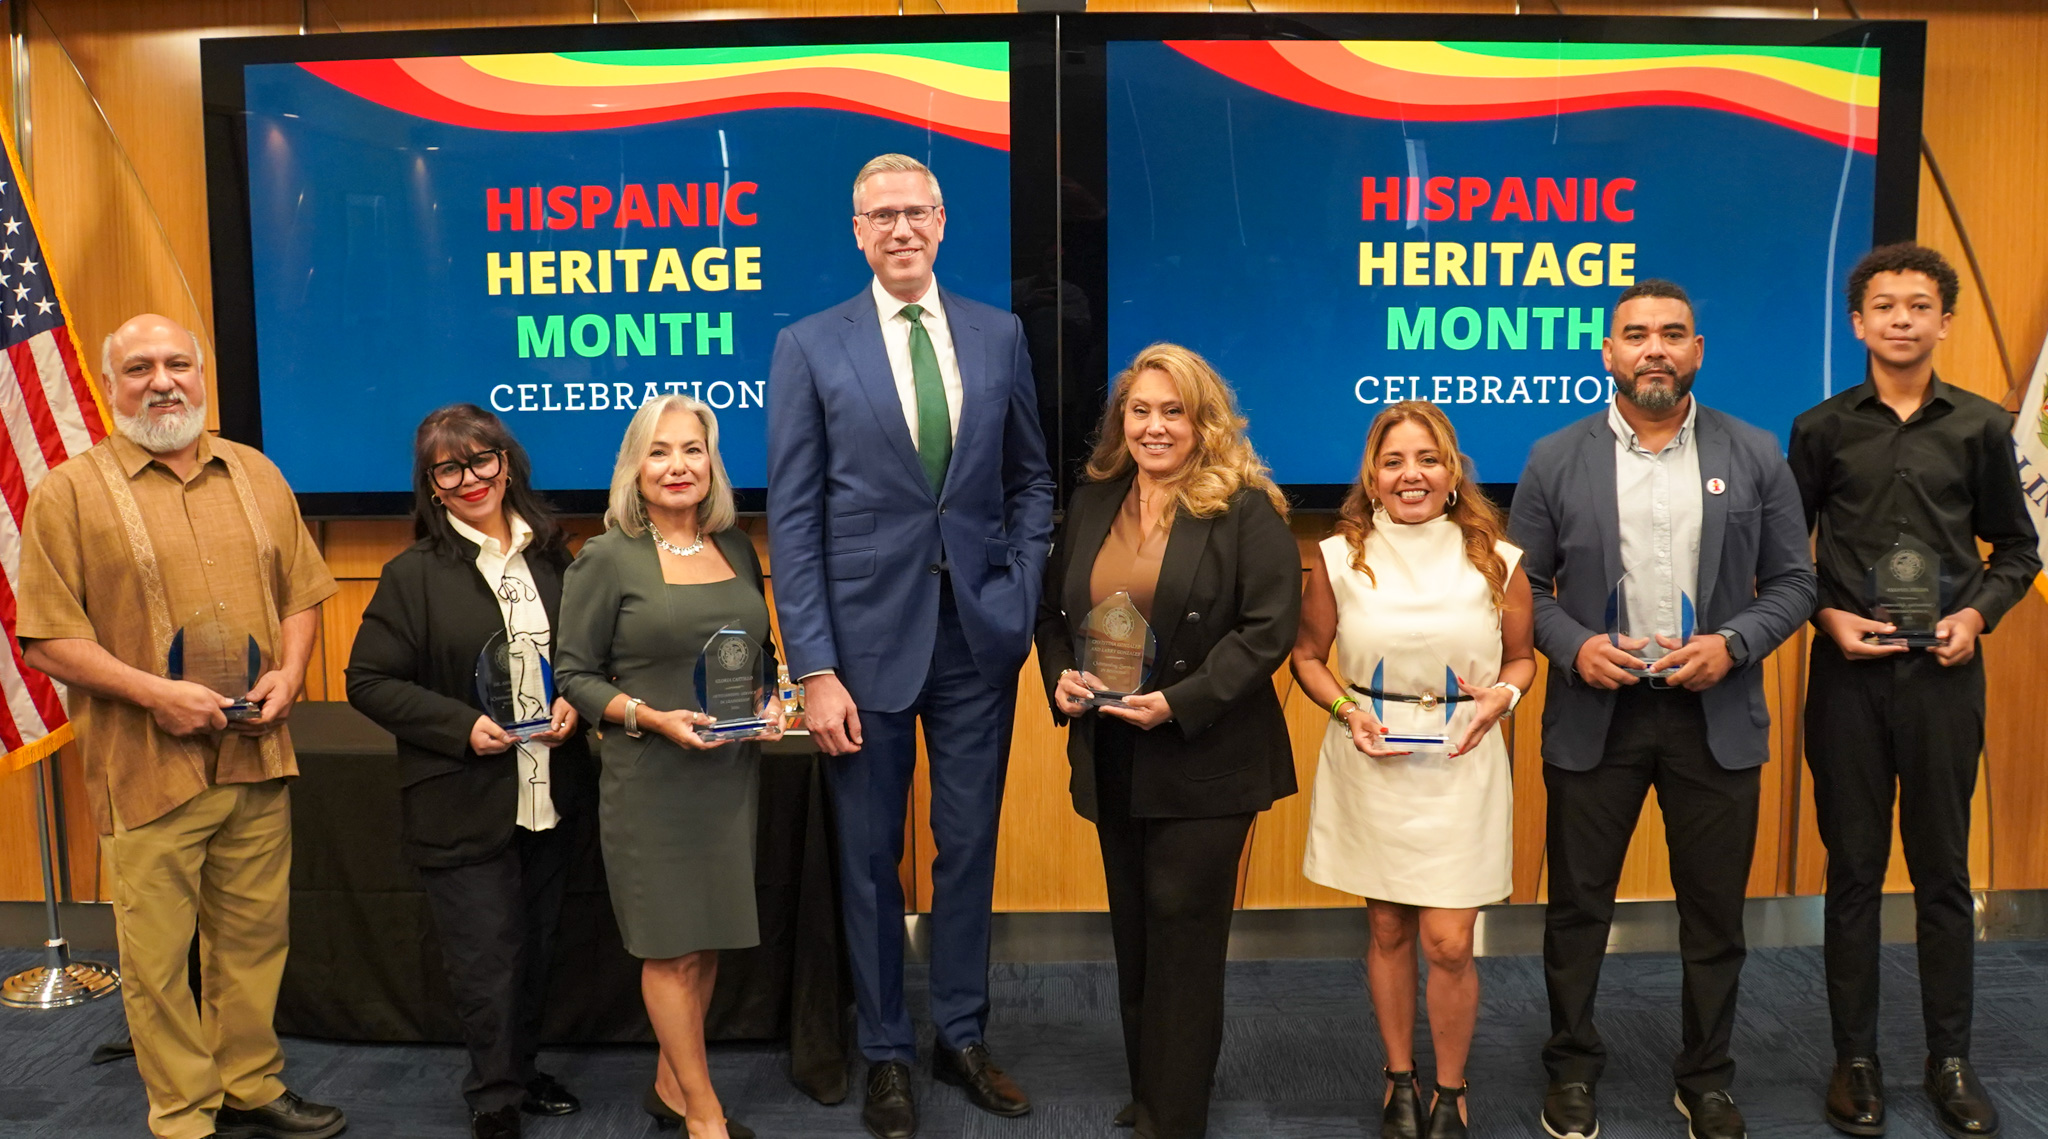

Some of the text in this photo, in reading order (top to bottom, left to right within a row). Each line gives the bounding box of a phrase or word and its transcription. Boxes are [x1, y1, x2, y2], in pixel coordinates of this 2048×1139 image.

[487, 182, 757, 231] HISPANIC
[1362, 177, 1635, 222] HISPANIC
[488, 247, 761, 295] HERITAGE
[1360, 243, 1635, 286] HERITAGE
[518, 312, 733, 357] MONTH
[1388, 307, 1603, 350] MONTH
[491, 381, 765, 411] CELEBRATION
